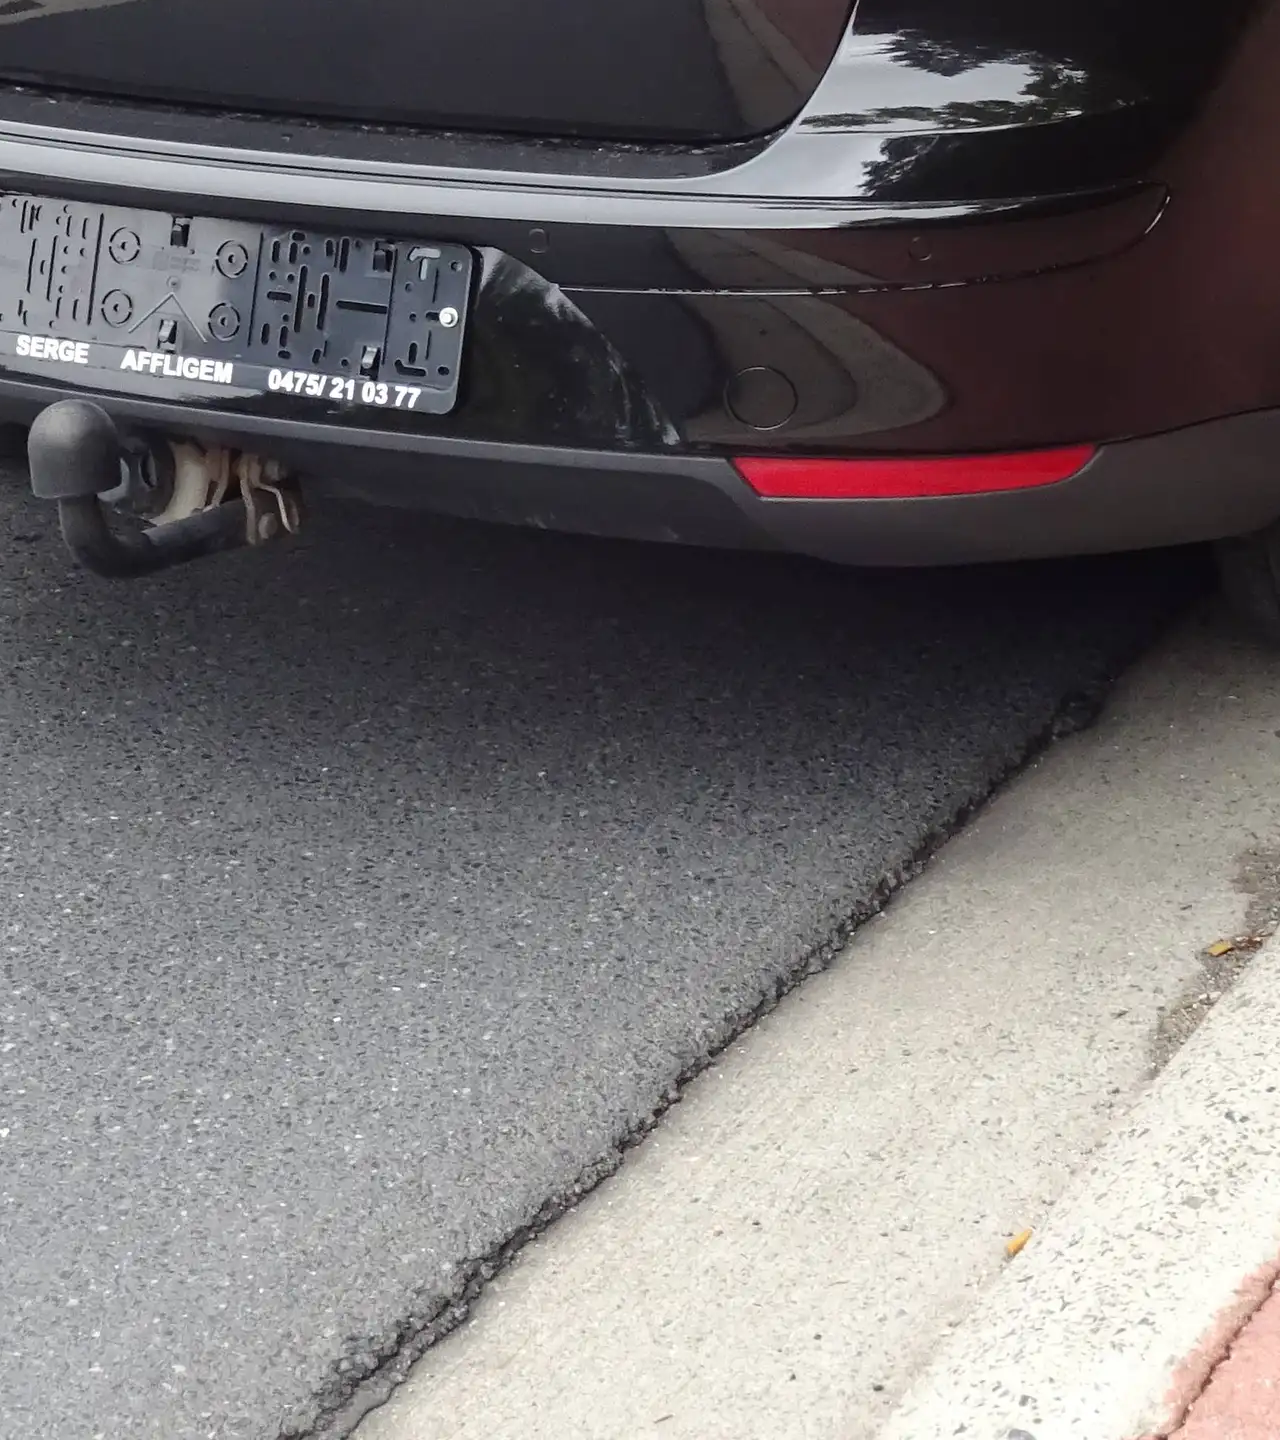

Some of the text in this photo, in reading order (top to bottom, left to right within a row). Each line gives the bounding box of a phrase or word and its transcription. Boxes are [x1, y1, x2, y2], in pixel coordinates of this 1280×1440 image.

[16, 334, 90, 364] SERGE
[120, 349, 233, 384] AFFLIGEM
[268, 369, 326, 396] 0475/
[332, 378, 355, 401] 21
[362, 384, 388, 405] 03
[396, 386, 421, 409] 77
